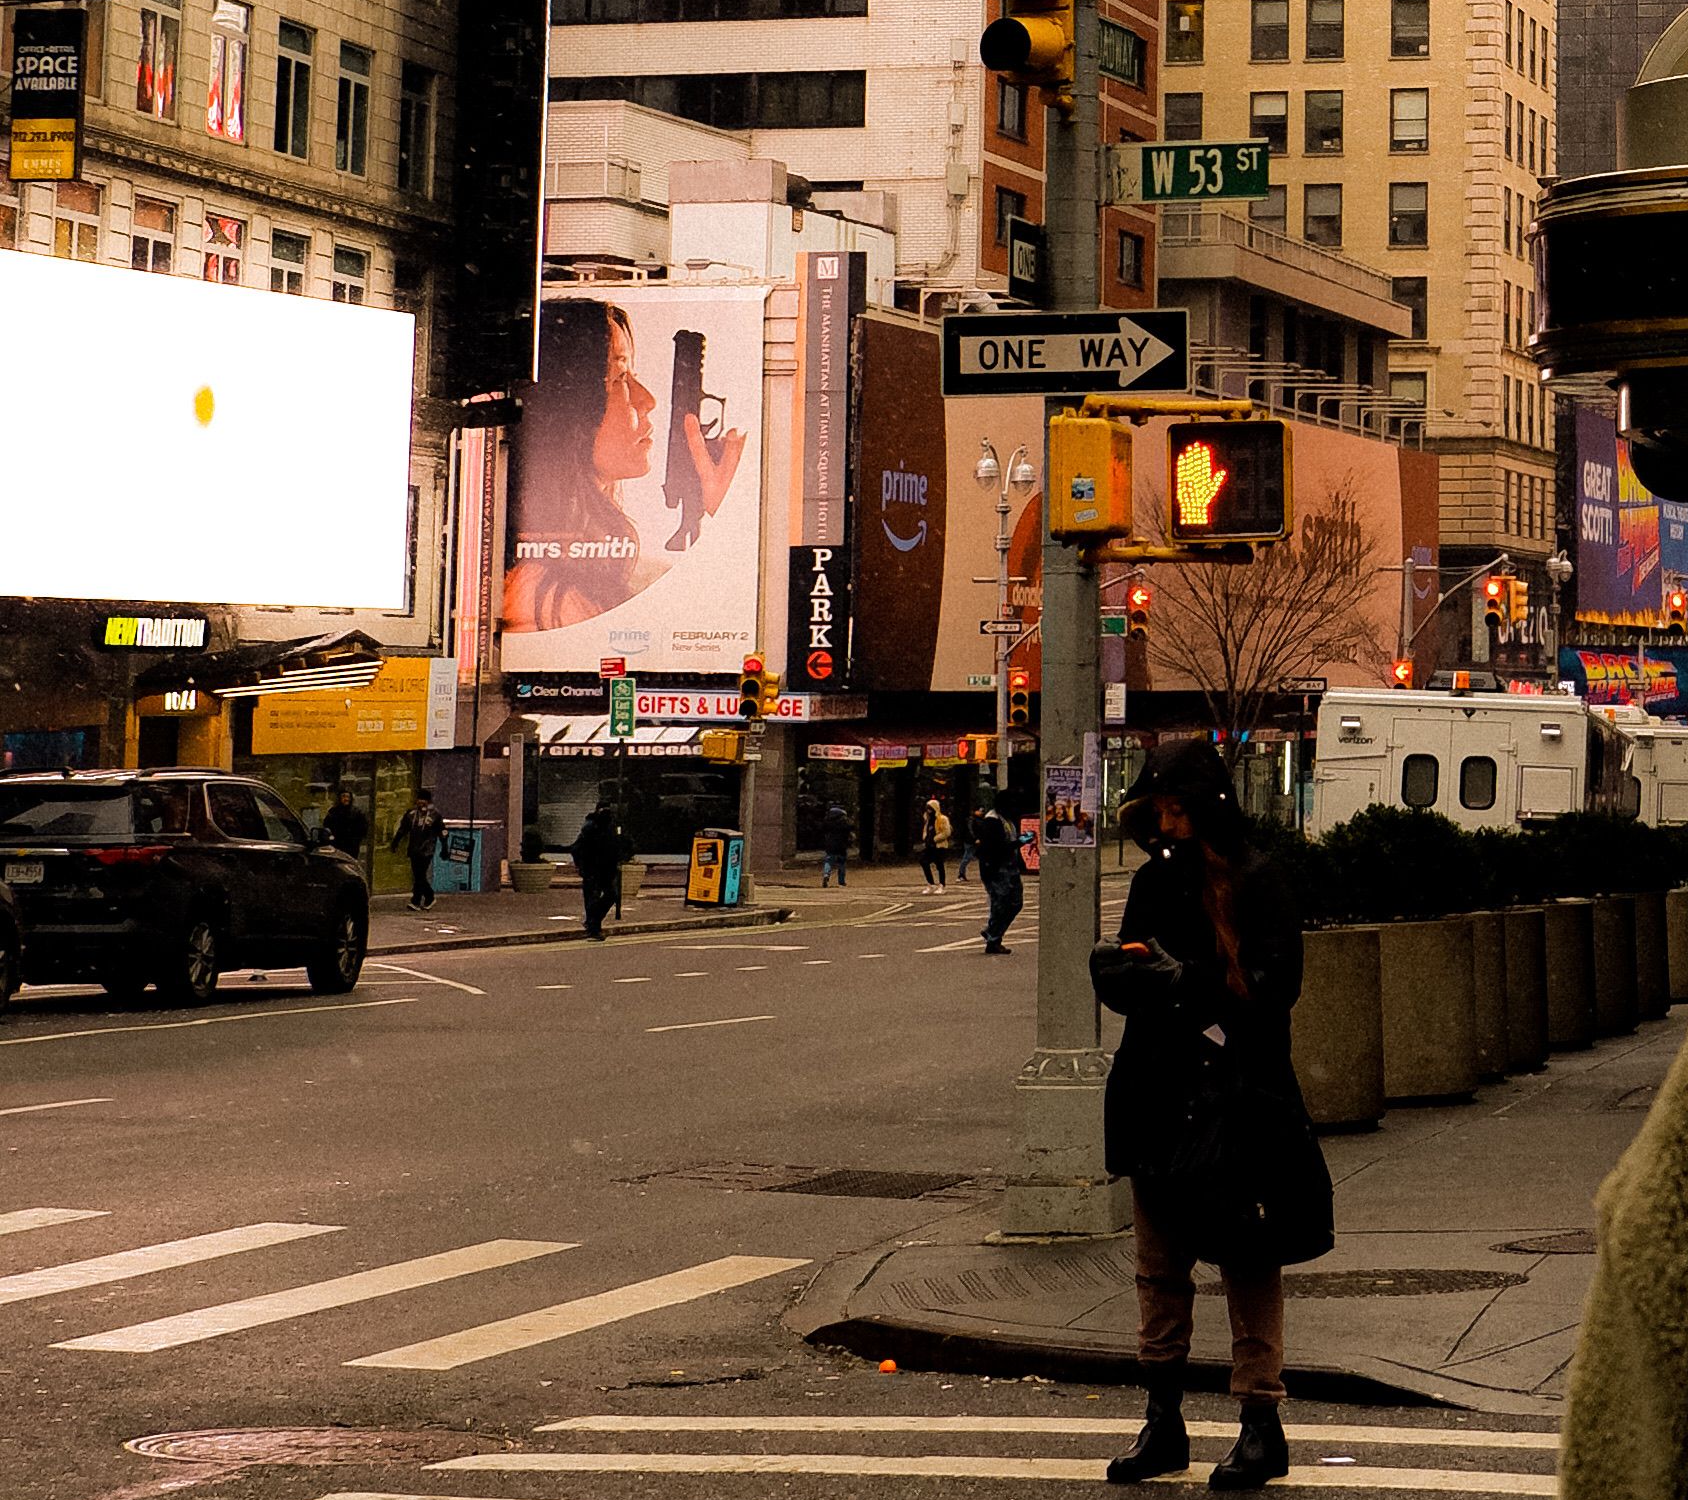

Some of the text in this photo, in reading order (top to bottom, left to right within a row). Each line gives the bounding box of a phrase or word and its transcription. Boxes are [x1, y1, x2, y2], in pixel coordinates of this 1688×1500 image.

[15, 56, 78, 74] SPACE
[15, 77, 77, 91] AVAILABLE
[1151, 147, 1261, 195] W 53 ST
[1017, 246, 1036, 278] ONE
[820, 314, 831, 391] MANHATTAN
[978, 337, 1150, 370] ONE WAY
[818, 411, 830, 447] TIMES
[817, 449, 830, 495] SQUARE
[882, 460, 928, 511] prime
[1583, 460, 1612, 502] GREAT
[1582, 503, 1613, 545] SCOTT!
[516, 535, 636, 559] mrs smith
[809, 548, 834, 648] PARK
[609, 631, 650, 643] prime
[672, 631, 748, 641] FEBRUARY 2
[532, 685, 603, 697] Clear Channel
[638, 697, 690, 714] GIFTS
[698, 698, 710, 715] &
[716, 698, 803, 718] LUGE
[549, 745, 605, 756] GIFTS
[628, 745, 704, 757] LUGGAG
[1338, 736, 1373, 744] verizon
